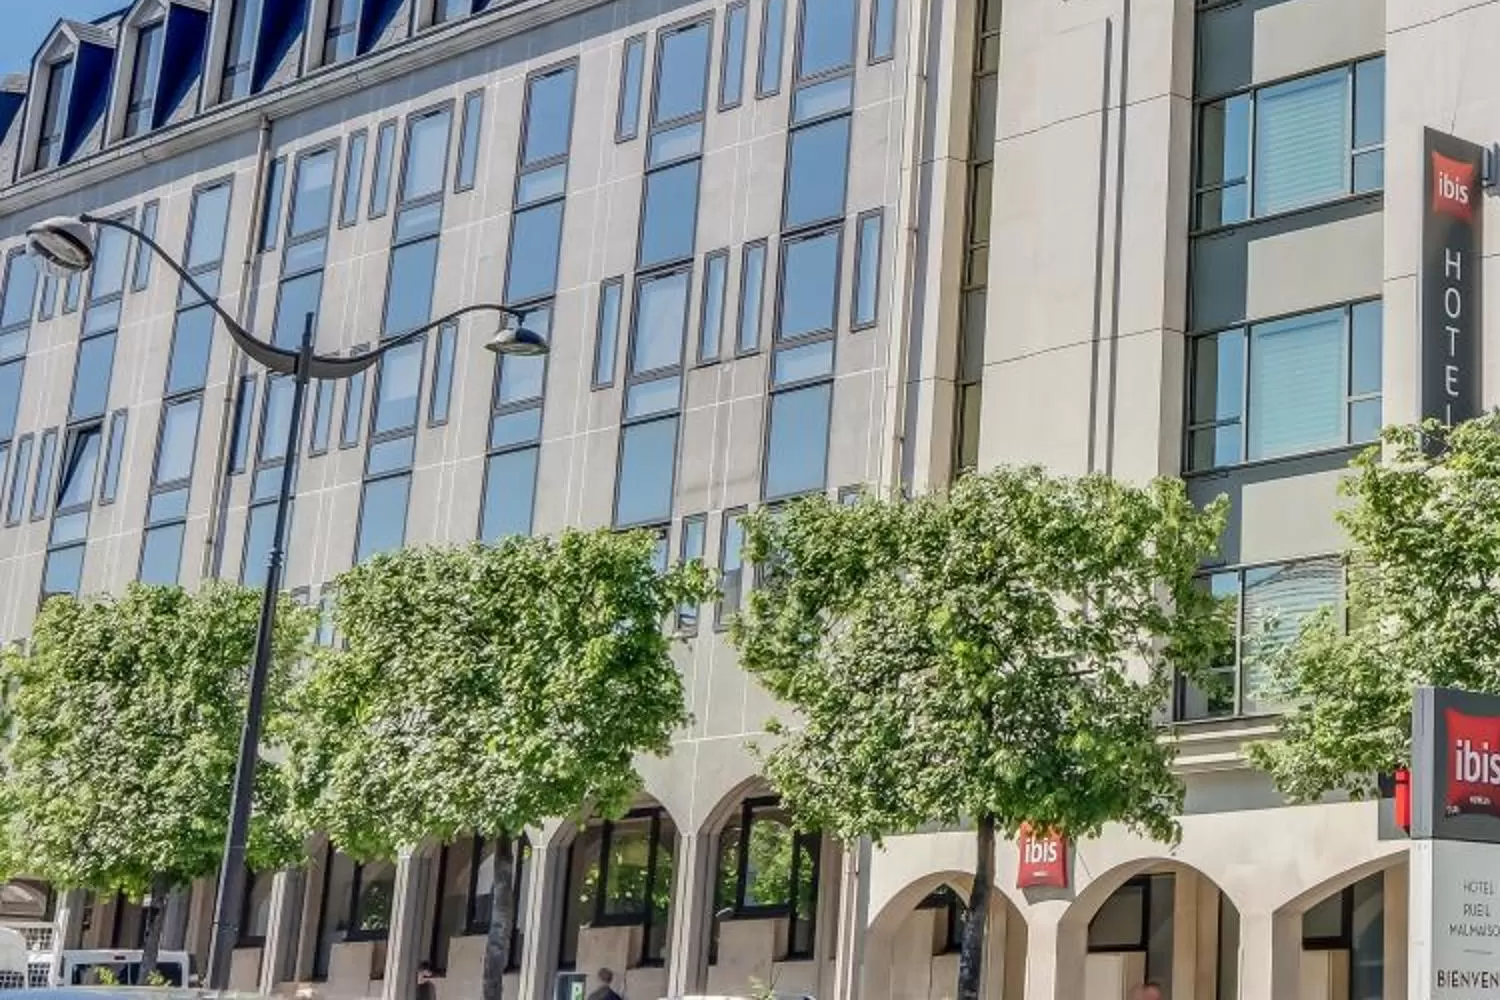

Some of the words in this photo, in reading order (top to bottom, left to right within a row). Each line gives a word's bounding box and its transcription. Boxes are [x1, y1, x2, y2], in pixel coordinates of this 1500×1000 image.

[1439, 171, 1469, 204] ibis
[1025, 835, 1058, 864] ibis
[1463, 880, 1495, 895] HOTEL
